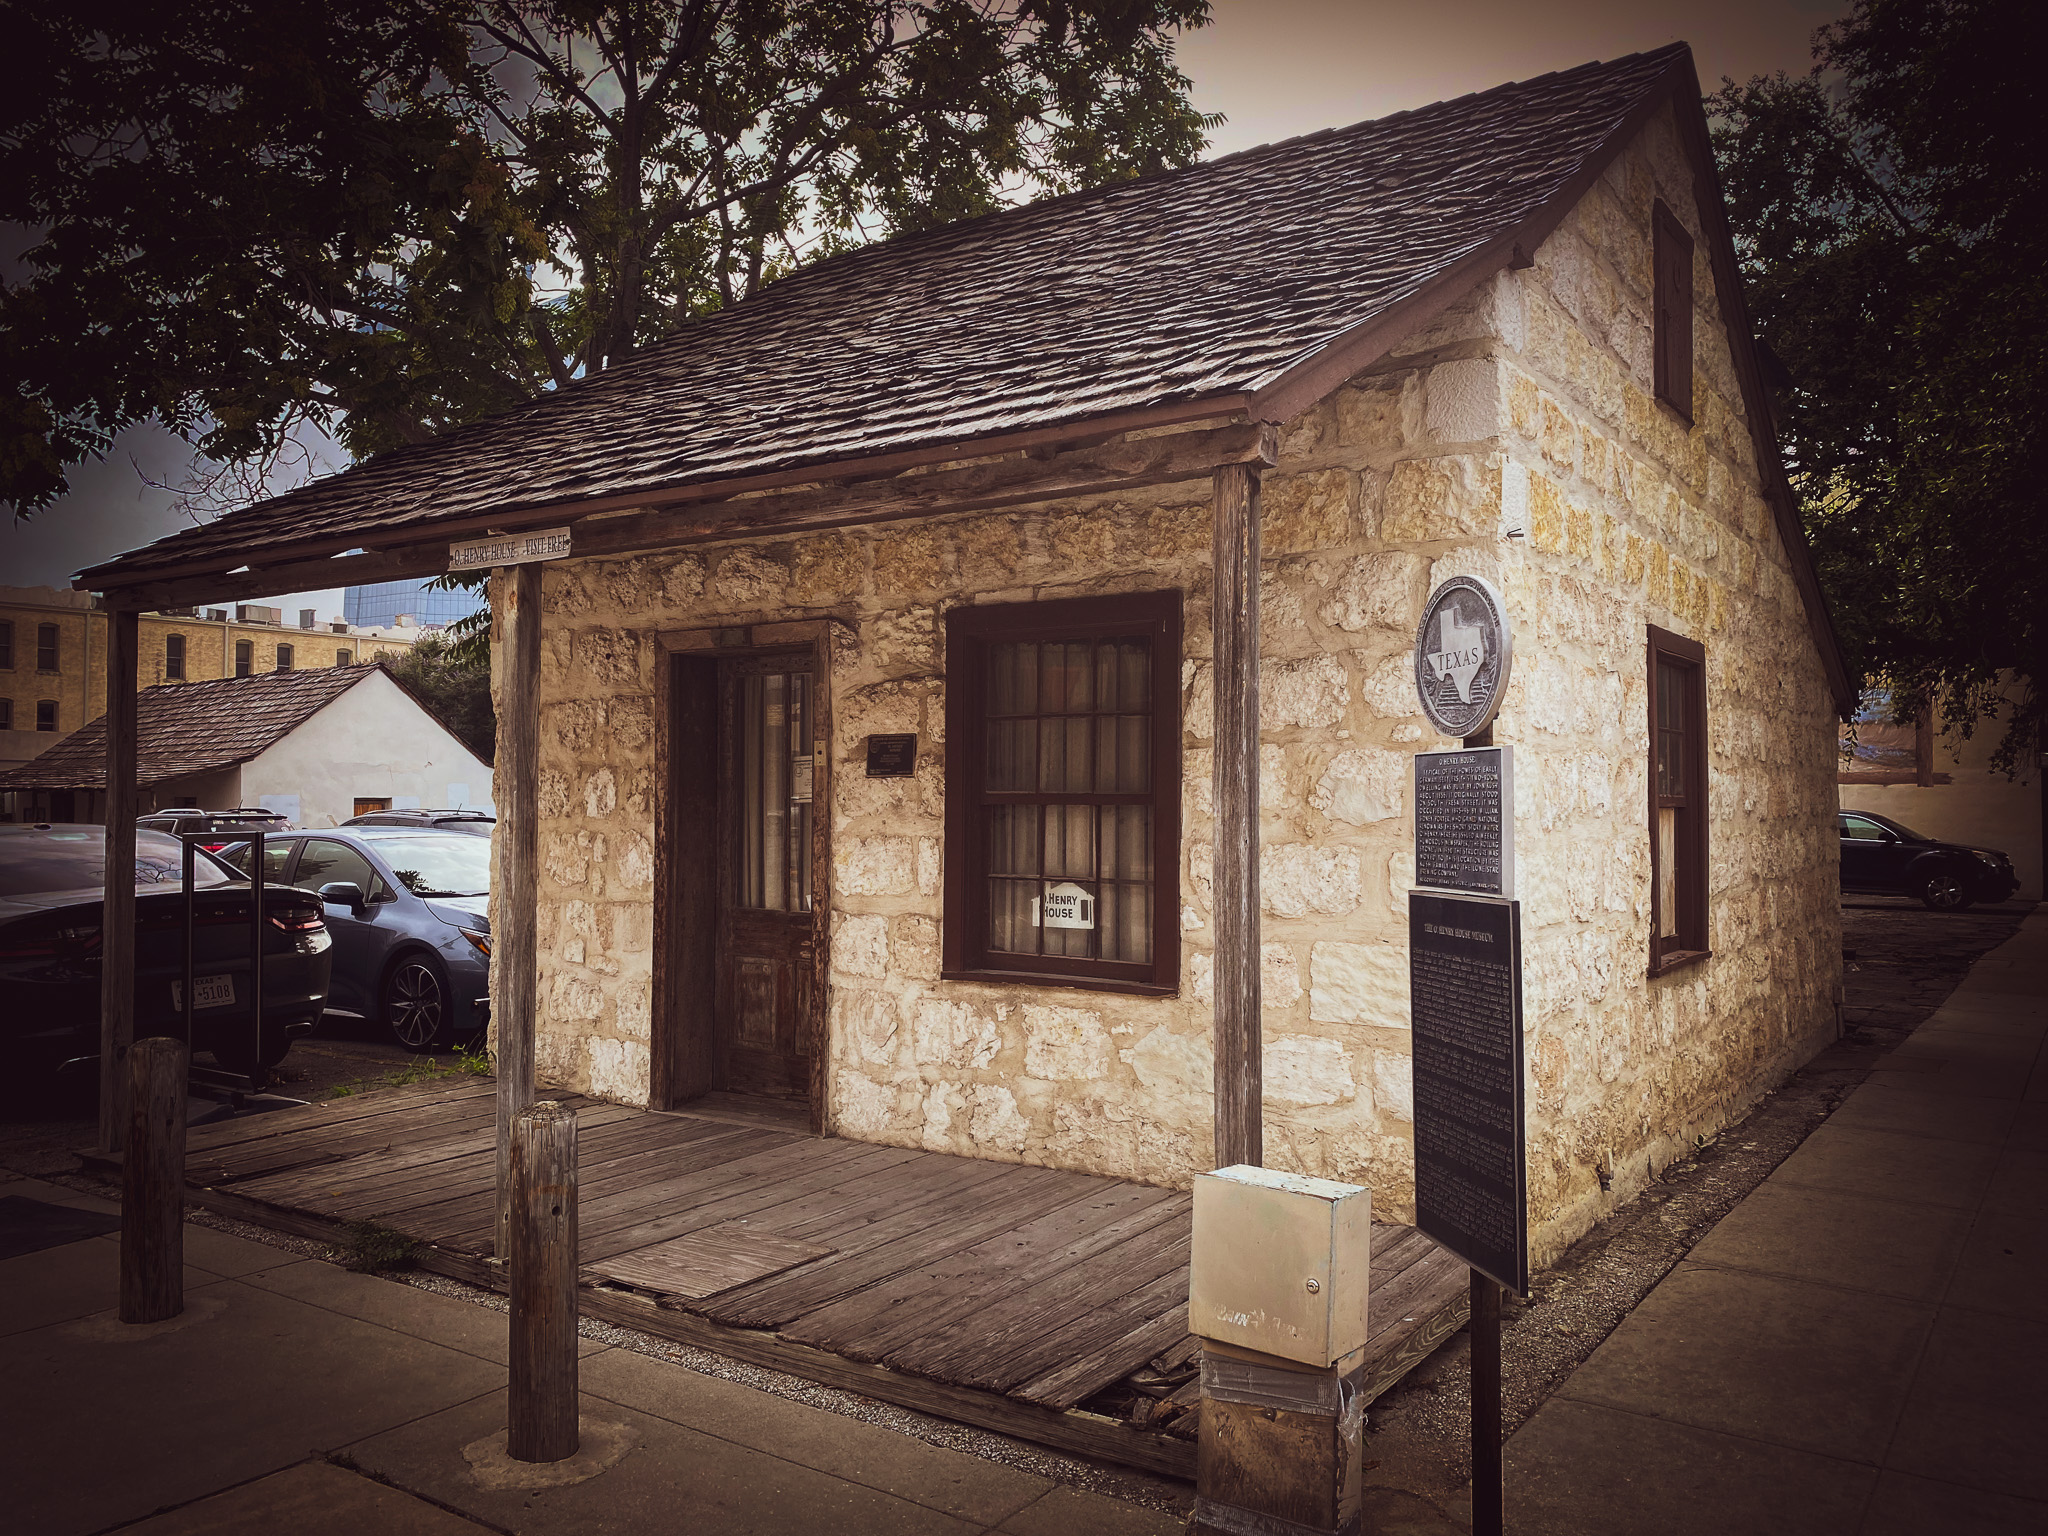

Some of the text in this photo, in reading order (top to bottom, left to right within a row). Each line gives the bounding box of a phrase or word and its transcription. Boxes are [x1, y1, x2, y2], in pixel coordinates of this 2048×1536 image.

[463, 545, 490, 564] HENRY
[491, 542, 516, 560] HOUSE
[525, 538, 546, 556] VISIT
[546, 534, 567, 552] FREE
[1438, 648, 1479, 671] TEXAS
[1444, 757, 1458, 765] HENRY
[1438, 926, 1454, 937] HENRY
[1454, 928, 1471, 940] HOUSE
[1471, 930, 1494, 943] MUSEUM
[195, 978, 214, 986] EXAS
